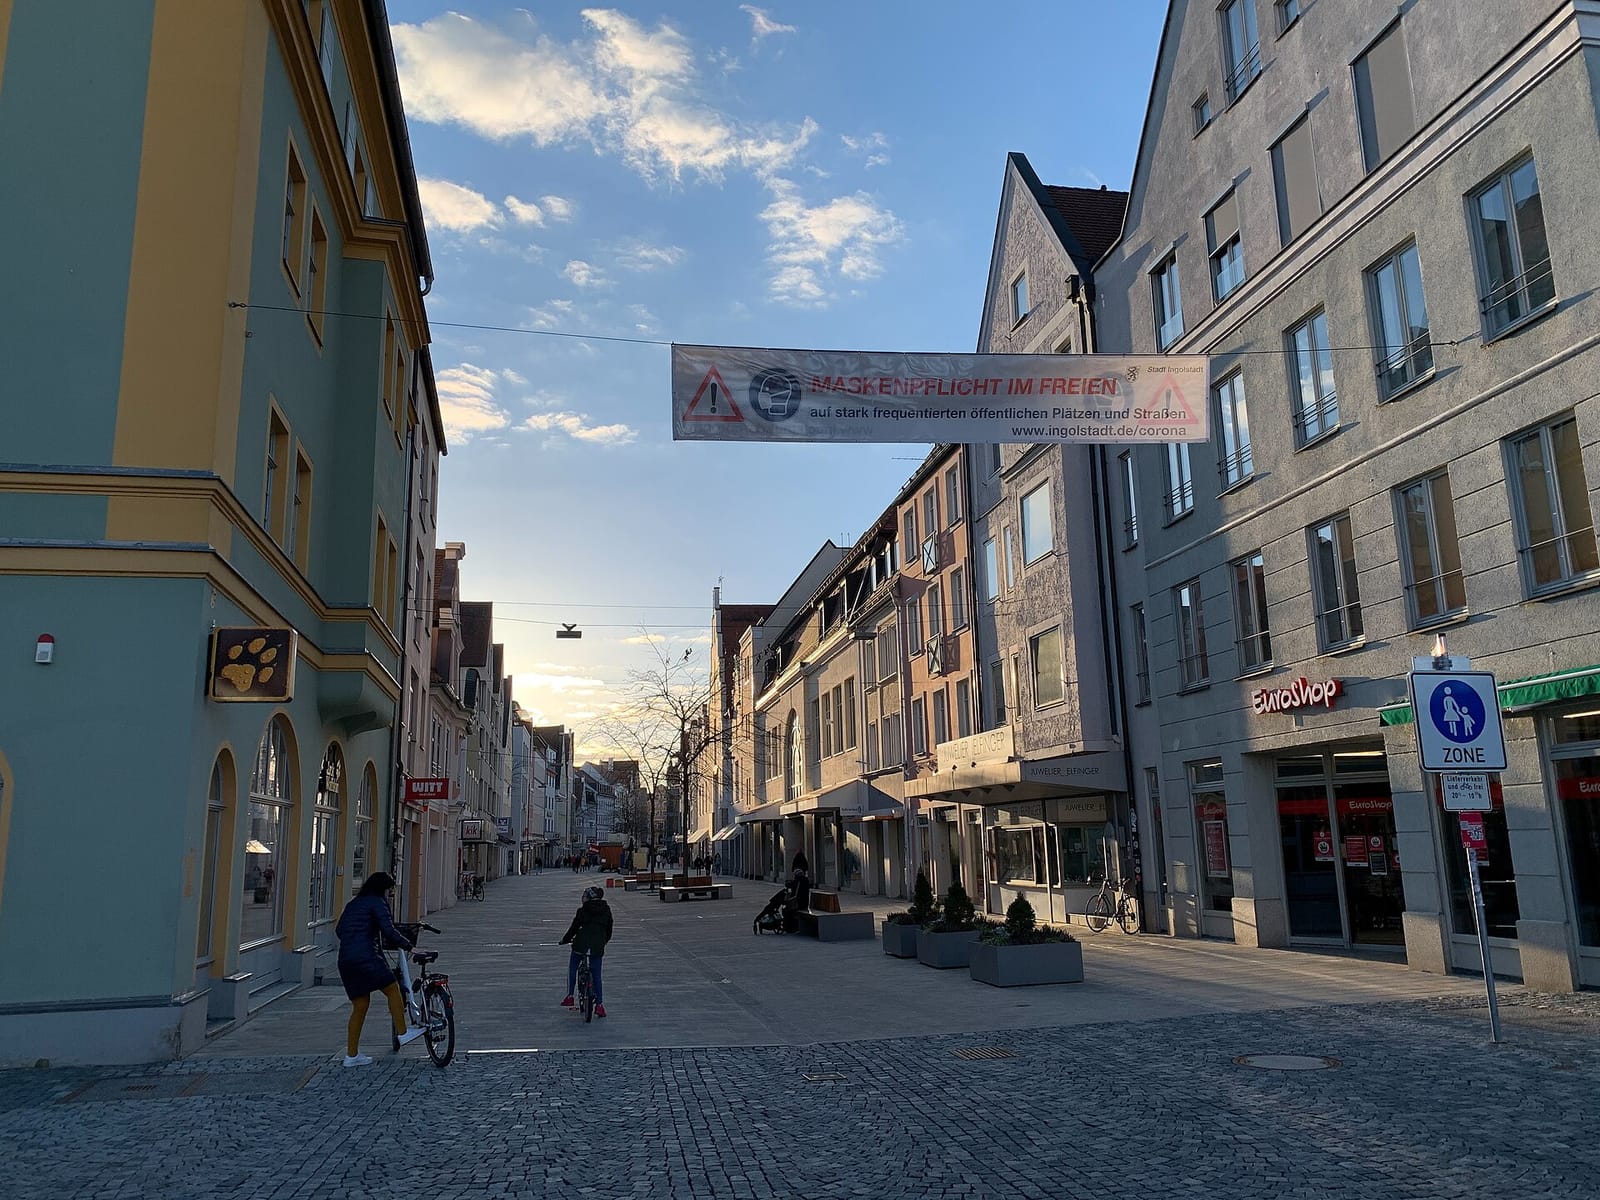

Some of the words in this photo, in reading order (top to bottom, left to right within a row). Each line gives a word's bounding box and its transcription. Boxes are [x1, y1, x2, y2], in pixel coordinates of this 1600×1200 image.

[1168, 366, 1204, 375] Ingolstadt
[810, 376, 1002, 396] MASKENPFLICHT
[1008, 378, 1034, 396] IM
[1039, 377, 1118, 396] FREIEN
[810, 406, 832, 418] auf
[835, 406, 869, 419] stark
[873, 406, 966, 421] frequentierten
[971, 407, 1048, 420] öffentlichen
[1052, 408, 1100, 420] Plätzen
[1104, 408, 1131, 420] und
[1133, 408, 1187, 420] Straßen
[1011, 425, 1187, 438] www.ingolstadt.de/corona
[1442, 748, 1486, 763] ZONE
[1031, 767, 1062, 777] JUWELIER
[1066, 767, 1100, 777] ELFINGER
[412, 782, 443, 793] WITT
[1065, 803, 1096, 812] JUWELIER
